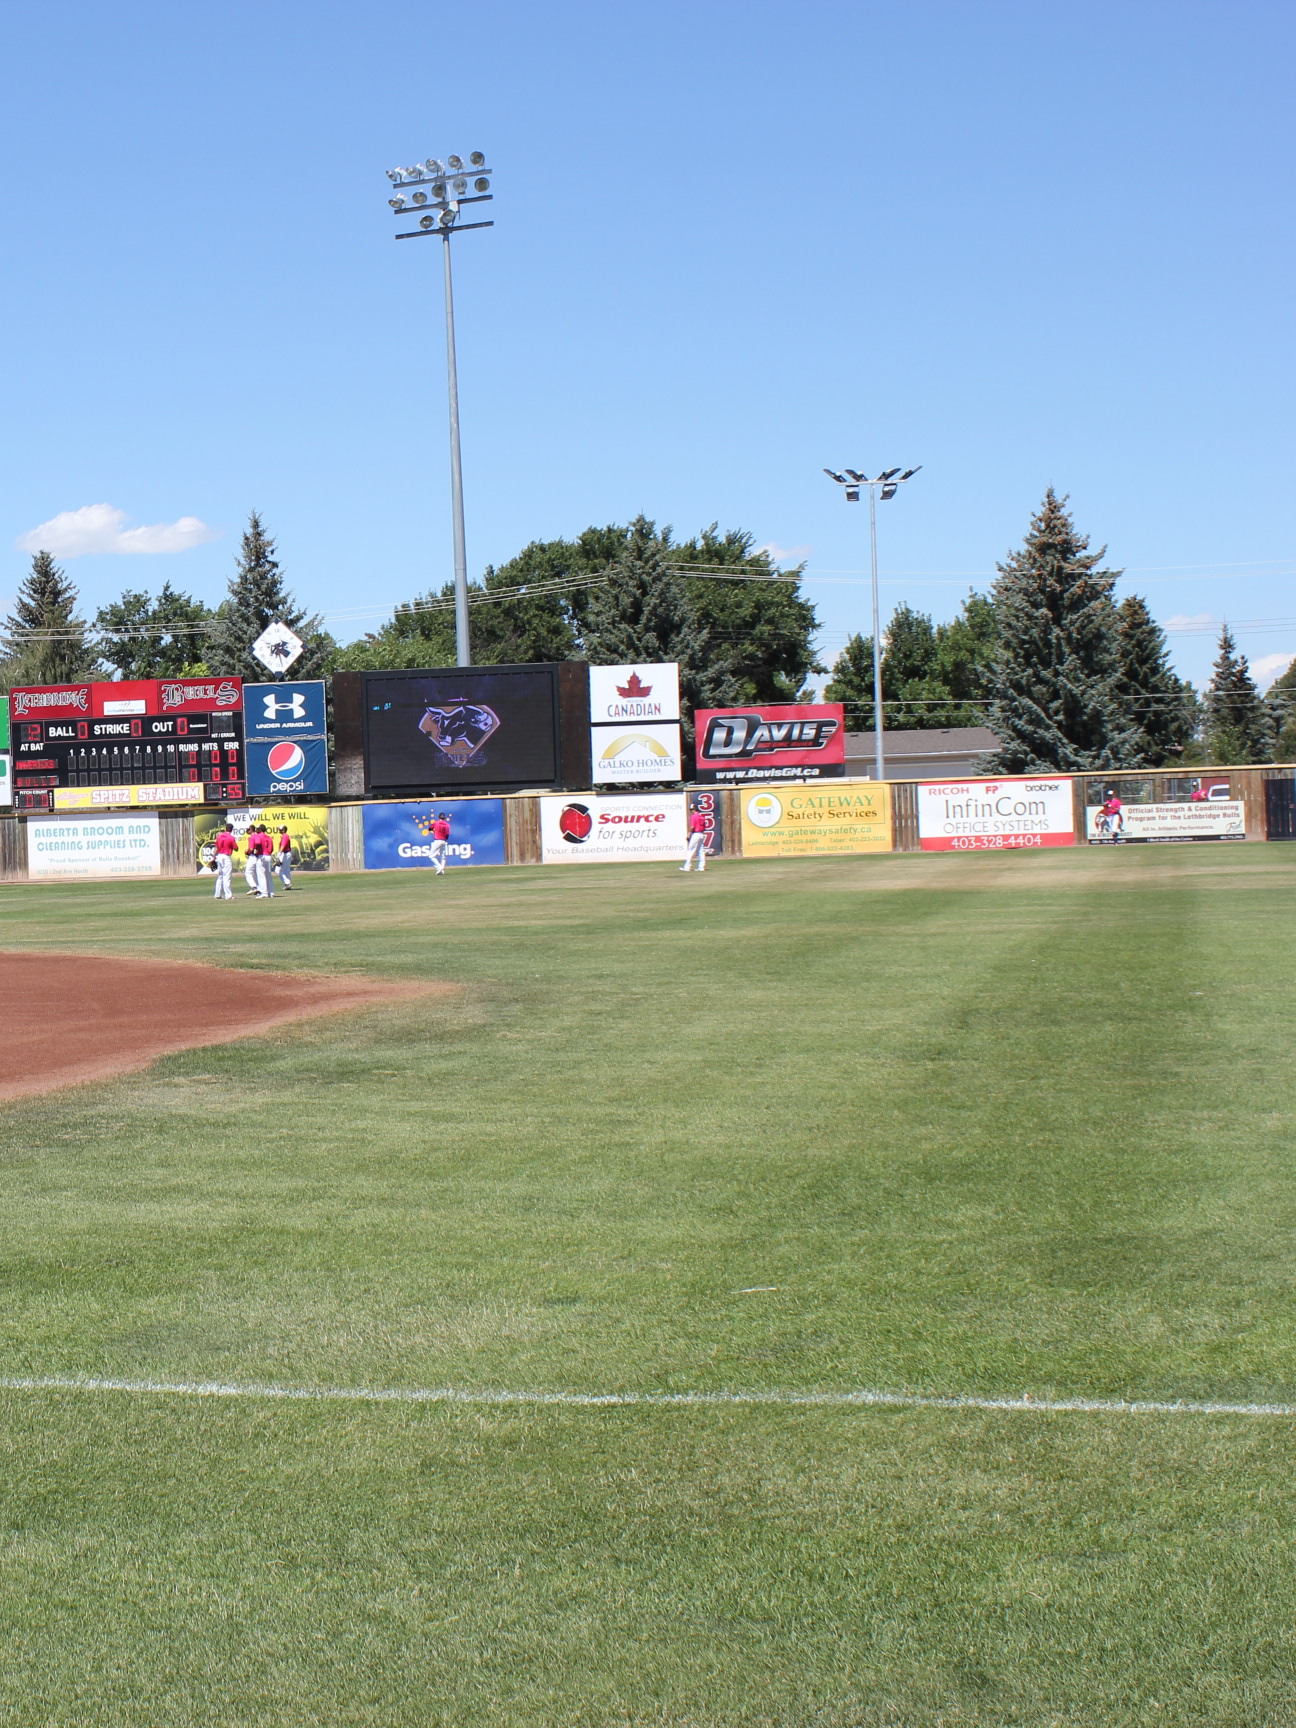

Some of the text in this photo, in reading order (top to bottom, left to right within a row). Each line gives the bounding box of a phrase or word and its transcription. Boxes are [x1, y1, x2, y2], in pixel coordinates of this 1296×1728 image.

[607, 703, 661, 717] CANADIAN
[48, 726, 75, 737] BALL
[77, 722, 88, 739] 0
[94, 724, 130, 735] STRIKE
[131, 719, 142, 737] 0
[152, 722, 173, 732] OUT
[176, 717, 188, 735] 0
[708, 718, 818, 755] DAVIS
[30, 743, 44, 751] BAT
[179, 743, 198, 751] RUNS
[202, 742, 218, 751] HITS
[224, 742, 239, 750] ERR
[598, 758, 675, 769] GALKO HOMES
[716, 767, 820, 779] www.DavisGM.ca
[270, 780, 304, 793] pepsi
[928, 787, 970, 796] RICOH
[1025, 783, 1060, 792] brother
[91, 789, 131, 804] SPITZ
[137, 786, 200, 802] STADIUM
[632, 804, 683, 812] CONNECTION
[790, 795, 874, 809] GATEWAY
[945, 796, 1046, 819] InfinCom
[787, 808, 877, 822] Safety Services
[1155, 806, 1184, 814] Strength
[1194, 804, 1239, 812] Conditioning
[234, 814, 246, 822] WE
[272, 812, 286, 820] WE
[598, 813, 666, 825] Source
[34, 824, 151, 838] ALBERTA BROOM AND
[762, 826, 872, 838] www.gatewaysafety.ca
[943, 819, 1049, 834] OFFICE SYSTEMS
[598, 828, 658, 842] for sports
[37, 838, 150, 852] CLEANING SUPPLIES LTD.
[951, 835, 1042, 849] 403-328-4404
[571, 846, 614, 854] Baseball
[616, 844, 684, 854] Headquarters
